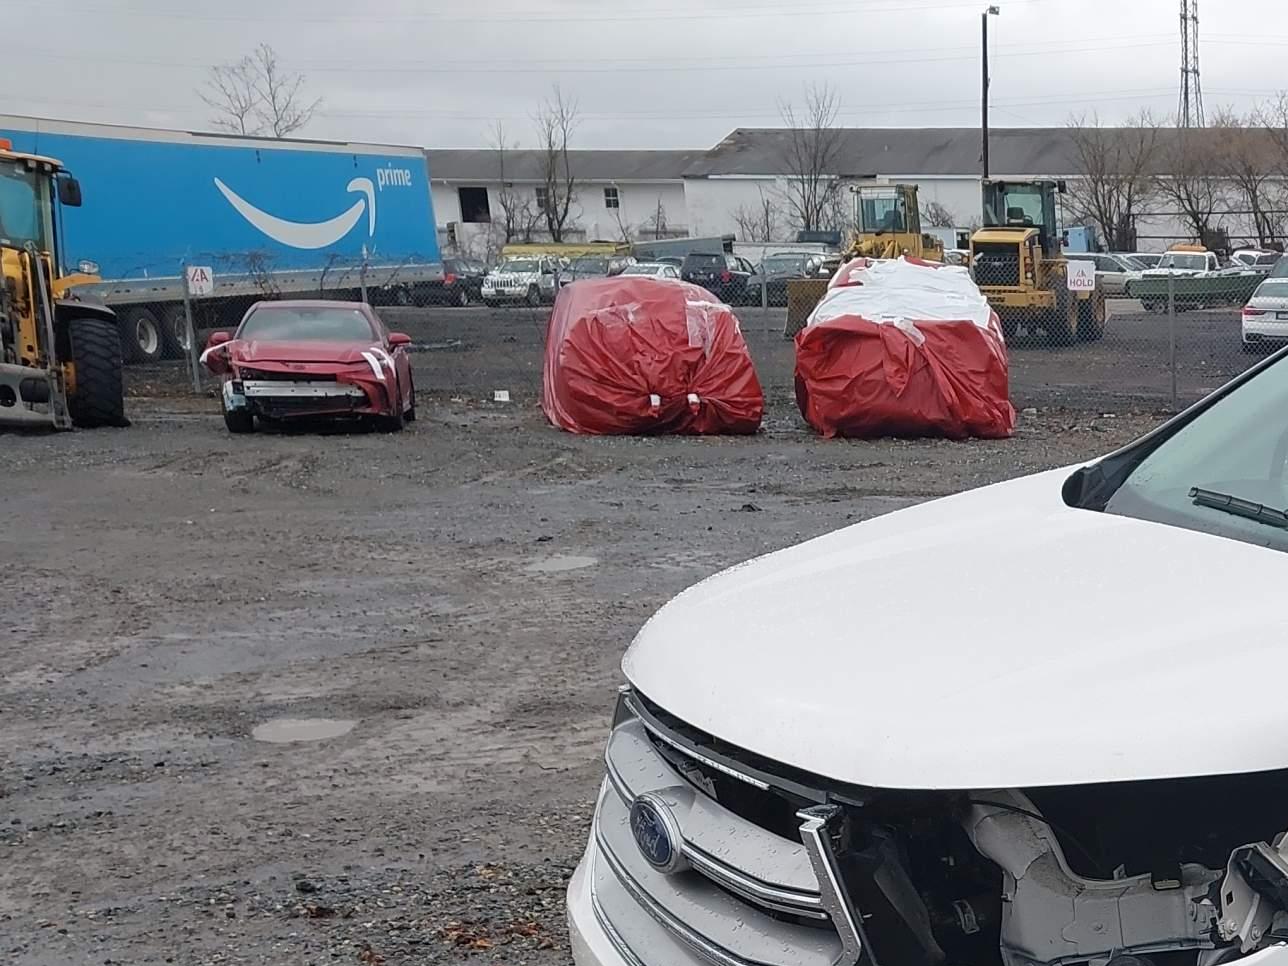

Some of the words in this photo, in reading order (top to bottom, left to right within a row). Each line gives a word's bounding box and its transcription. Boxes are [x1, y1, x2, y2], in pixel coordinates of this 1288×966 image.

[376, 161, 412, 192] prime
[1070, 279, 1093, 287] HOLD
[635, 809, 661, 858] Ford
